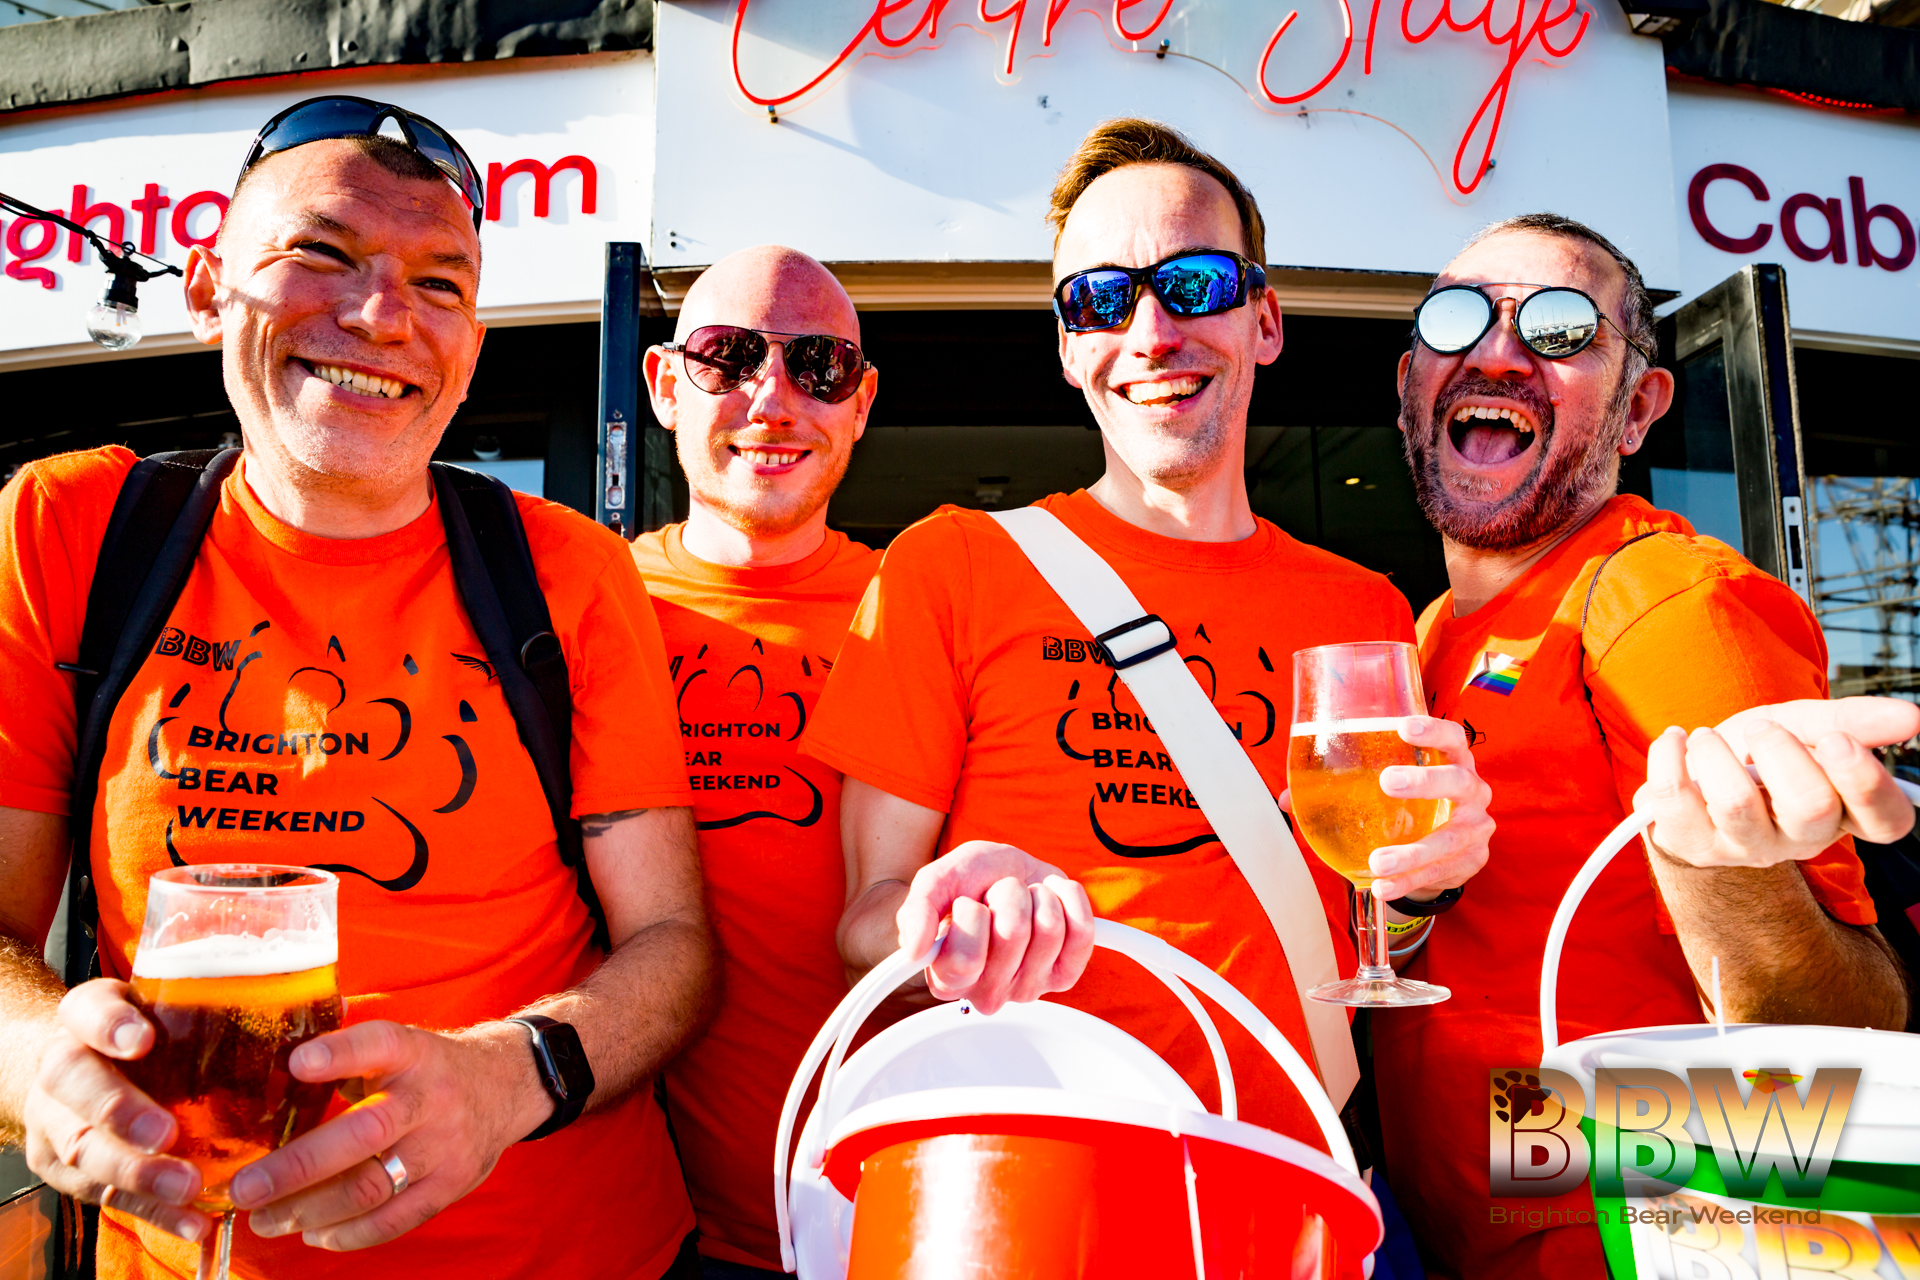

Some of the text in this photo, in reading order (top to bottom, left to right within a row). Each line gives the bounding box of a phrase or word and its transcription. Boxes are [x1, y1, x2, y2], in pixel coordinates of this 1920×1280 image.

[1688, 163, 1920, 272] Cab
[154, 626, 242, 672] BBW
[187, 725, 369, 755] BRIGHTON
[680, 722, 781, 738] RIGHTON
[1093, 748, 1174, 772] BEAR
[177, 767, 279, 796] BEAR
[689, 774, 781, 791] EEKEND
[1095, 781, 1202, 810] WEEKE
[177, 805, 365, 832] WEEKEND
